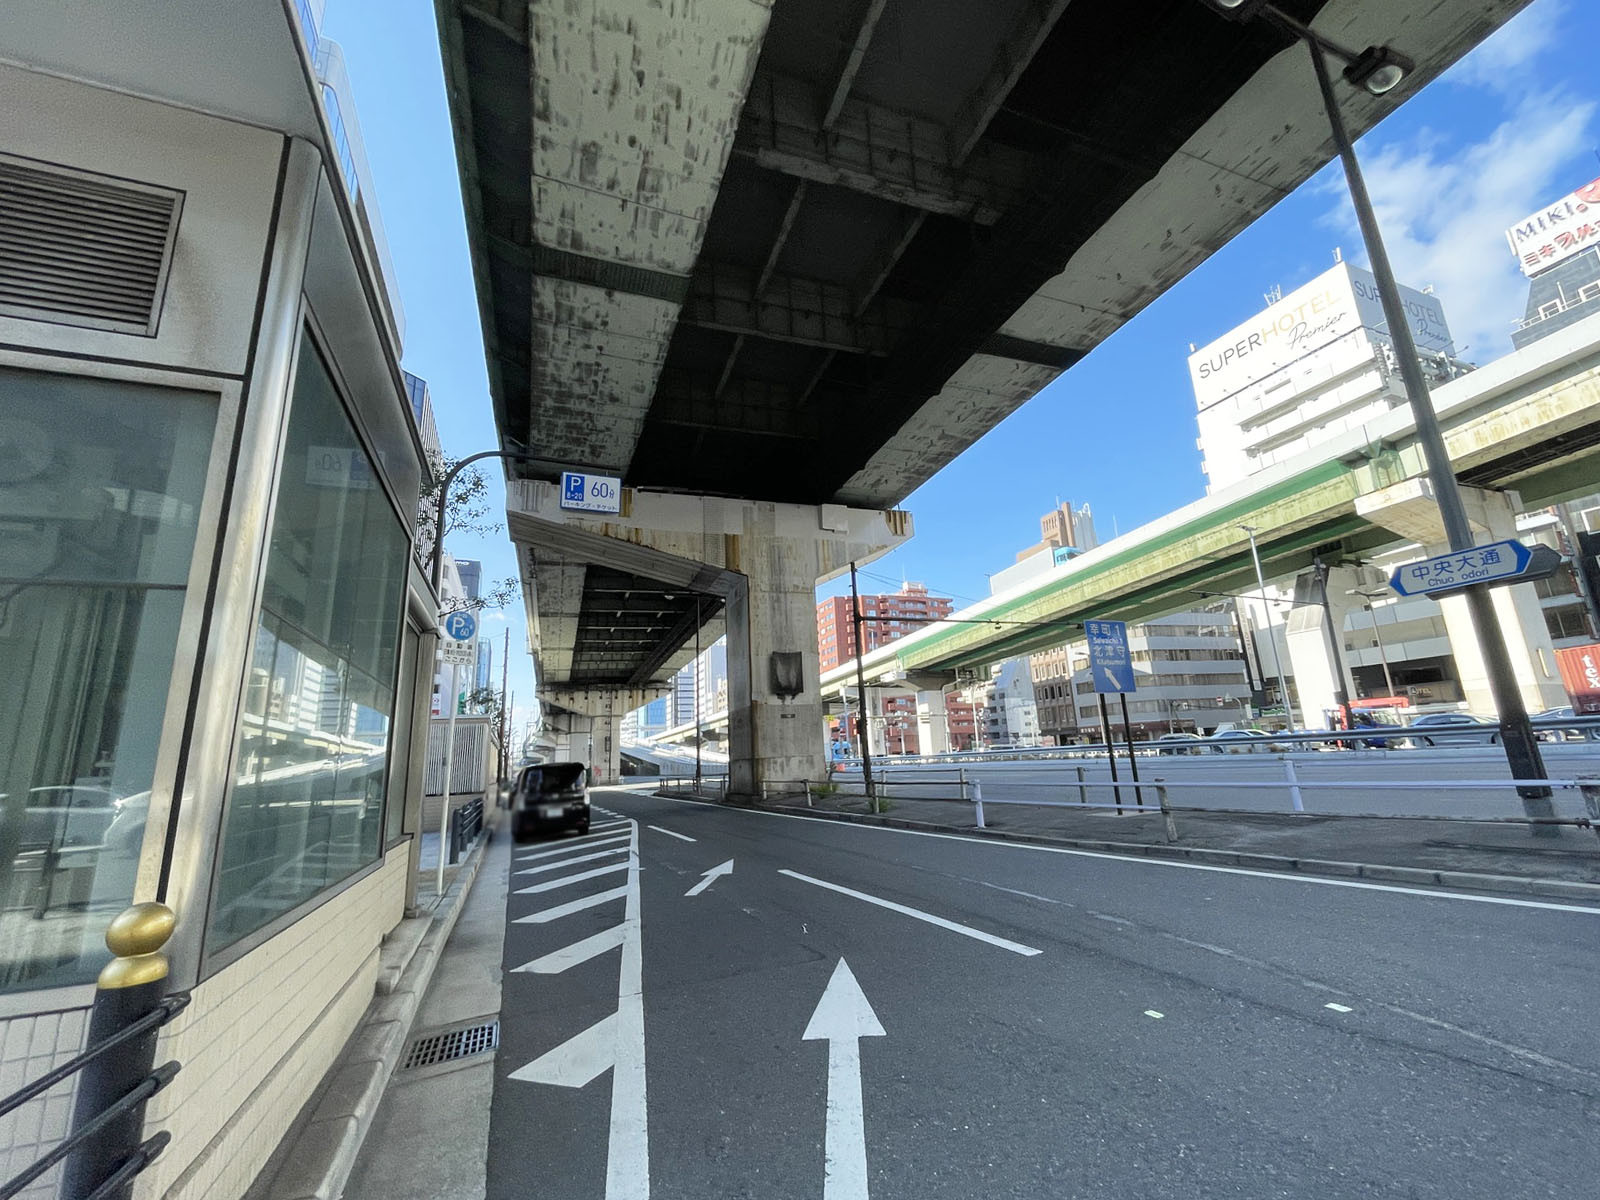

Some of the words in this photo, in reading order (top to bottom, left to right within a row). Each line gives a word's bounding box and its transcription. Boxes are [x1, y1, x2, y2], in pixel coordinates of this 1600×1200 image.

[1515, 202, 1575, 242] MIKI
[1287, 312, 1348, 349] Premier
[571, 477, 581, 491] P
[1412, 549, 1502, 580] 中央大通
[1428, 576, 1454, 587] Chuo
[1461, 568, 1489, 580] odori
[452, 616, 465, 635] P
